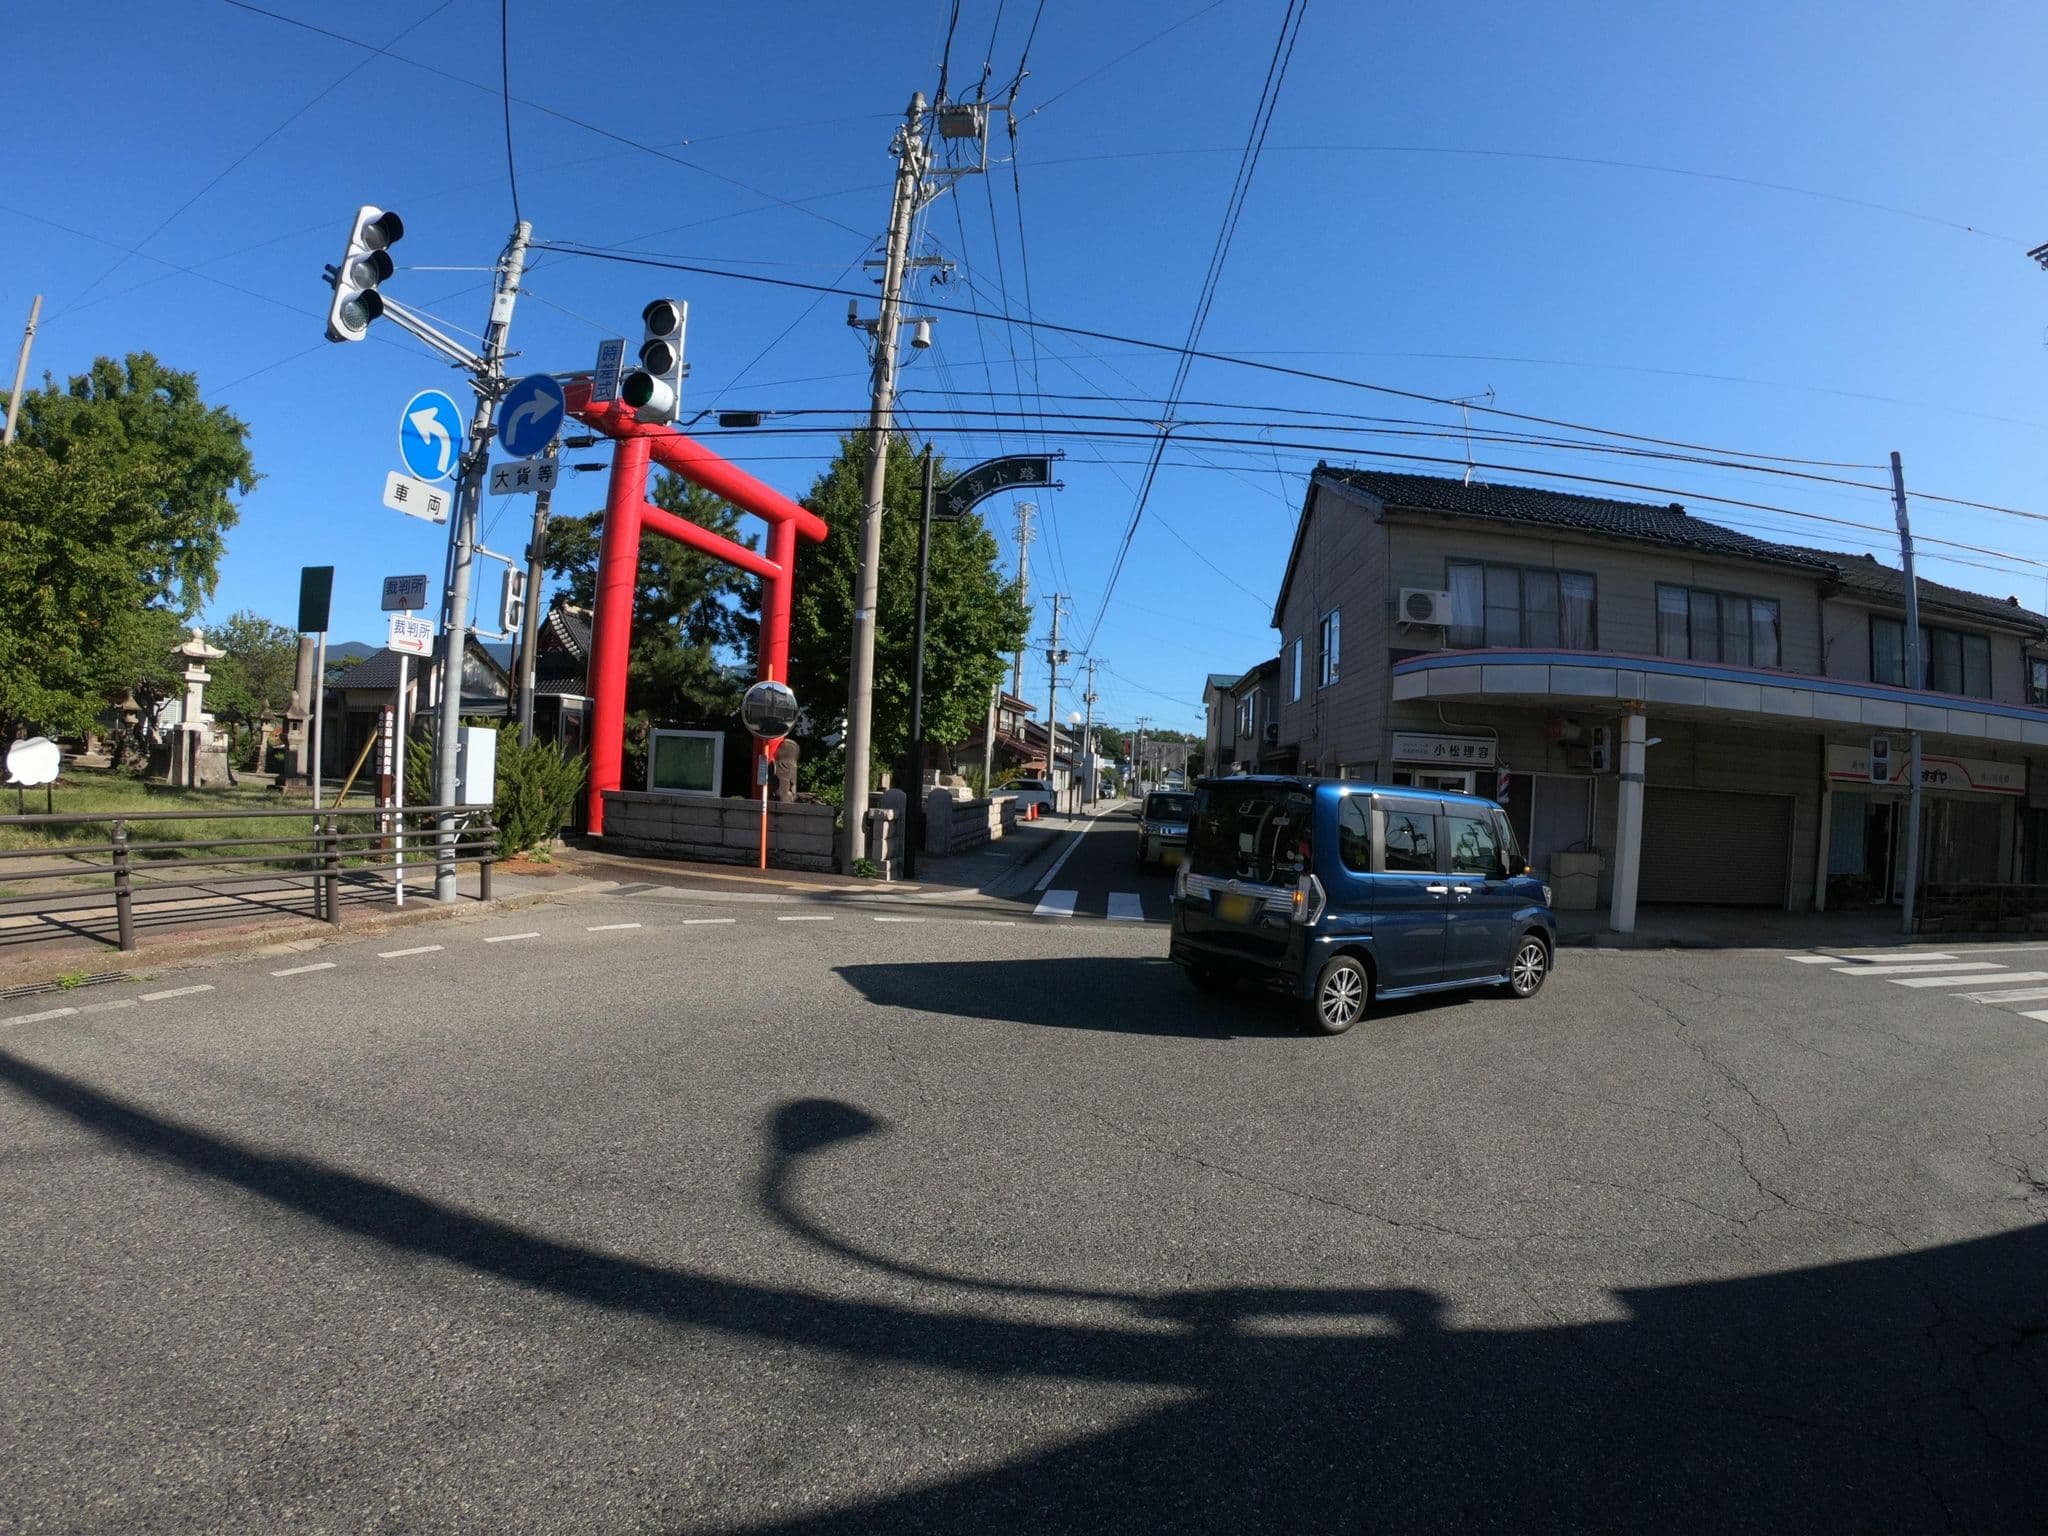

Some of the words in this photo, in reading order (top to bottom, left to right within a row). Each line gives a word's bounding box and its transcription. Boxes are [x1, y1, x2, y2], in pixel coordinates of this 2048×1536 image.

[495, 465, 553, 489] 大貨等
[394, 483, 442, 515] 車両
[385, 579, 423, 595] 裁判所
[394, 619, 431, 640] 裁判所
[1434, 744, 1489, 758] 小松理容
